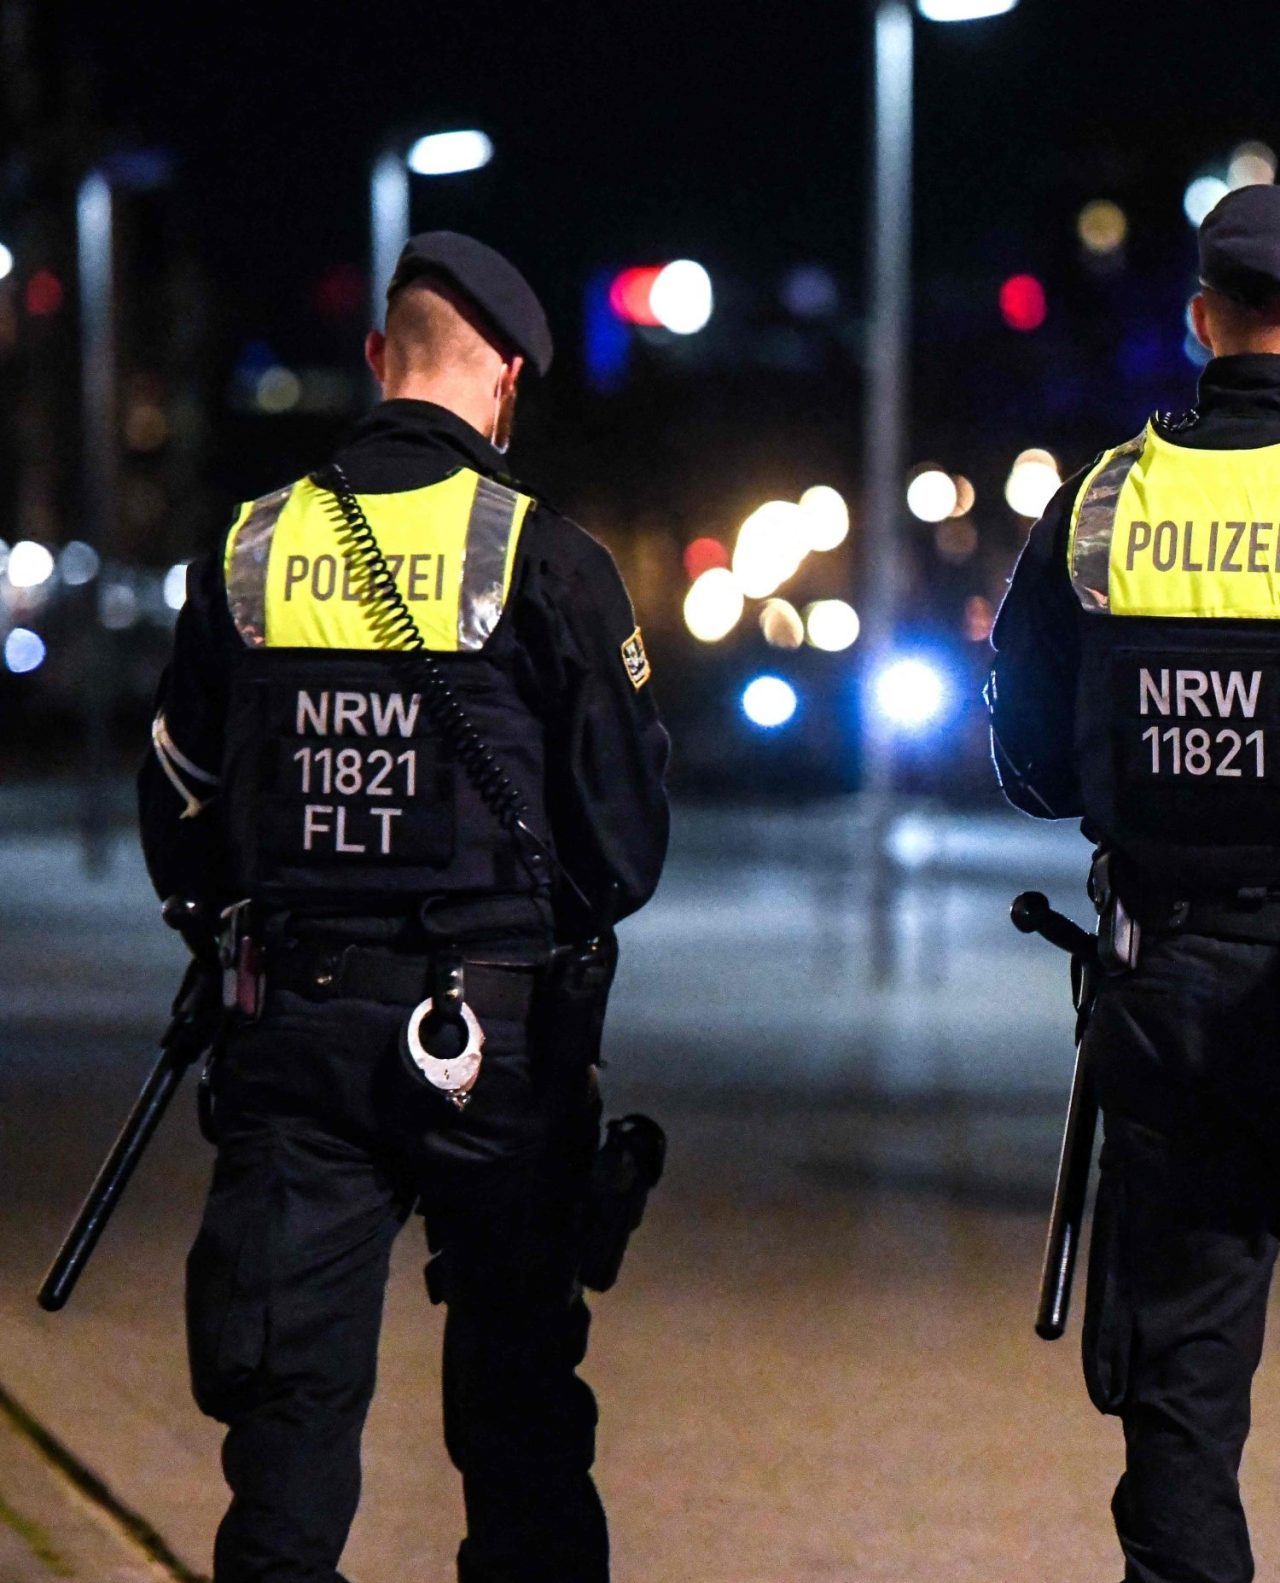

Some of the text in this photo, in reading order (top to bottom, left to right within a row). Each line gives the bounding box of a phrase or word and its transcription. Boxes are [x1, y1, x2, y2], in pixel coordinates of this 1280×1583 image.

[296, 691, 421, 737] NRW
[1139, 668, 1262, 718] NRW
[294, 748, 416, 797] 11821
[1142, 727, 1265, 777] 11821
[303, 805, 402, 854] FLT
